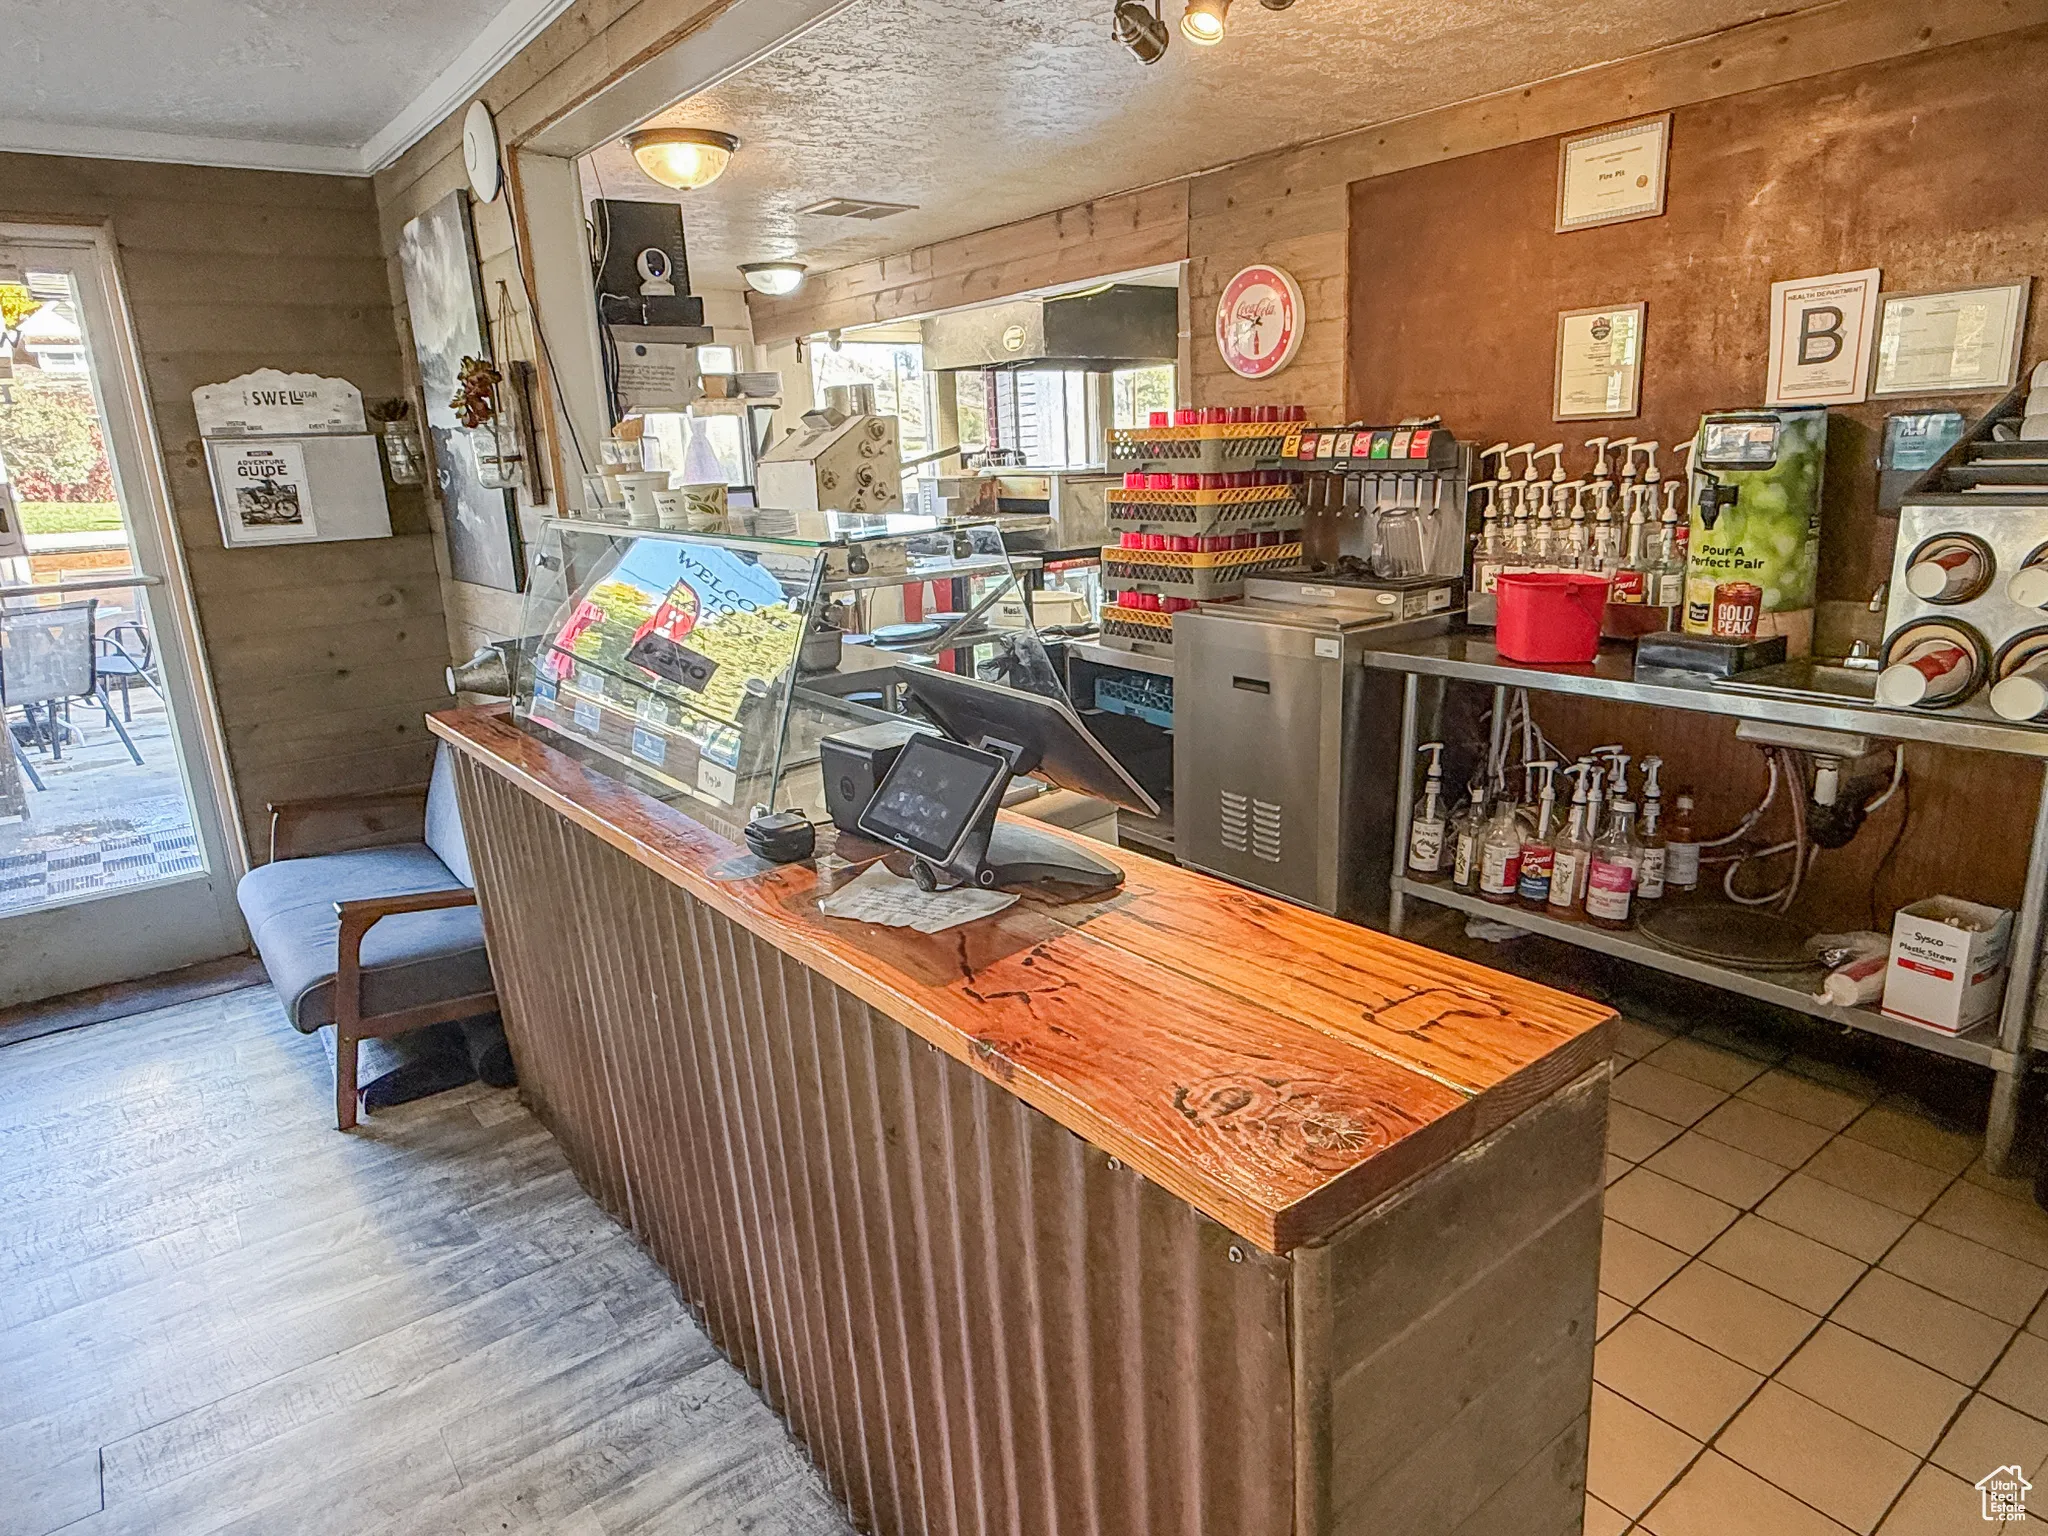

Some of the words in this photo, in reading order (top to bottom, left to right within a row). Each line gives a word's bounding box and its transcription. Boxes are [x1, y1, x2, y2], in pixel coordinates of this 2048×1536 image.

[1599, 173, 1612, 181] Fire
[1615, 169, 1625, 177] Pit
[1788, 292, 1815, 300] HEALTH
[1816, 286, 1862, 297] DEPARTMENT
[1797, 305, 1843, 366] B
[252, 390, 304, 405] SWELL
[237, 465, 288, 477] GUIDE
[1702, 545, 1731, 556] Pour
[1734, 547, 1745, 557] A
[1691, 555, 1730, 568] Perfect
[1734, 558, 1765, 569] Pair
[678, 549, 789, 632] WELCOME
[707, 593, 737, 617] TO
[1718, 603, 1754, 621] GOLD
[1717, 620, 1752, 634] PEAK
[1914, 932, 1944, 947] Sysco
[1899, 942, 1926, 955] Plastic
[1927, 950, 1958, 963] Straws
